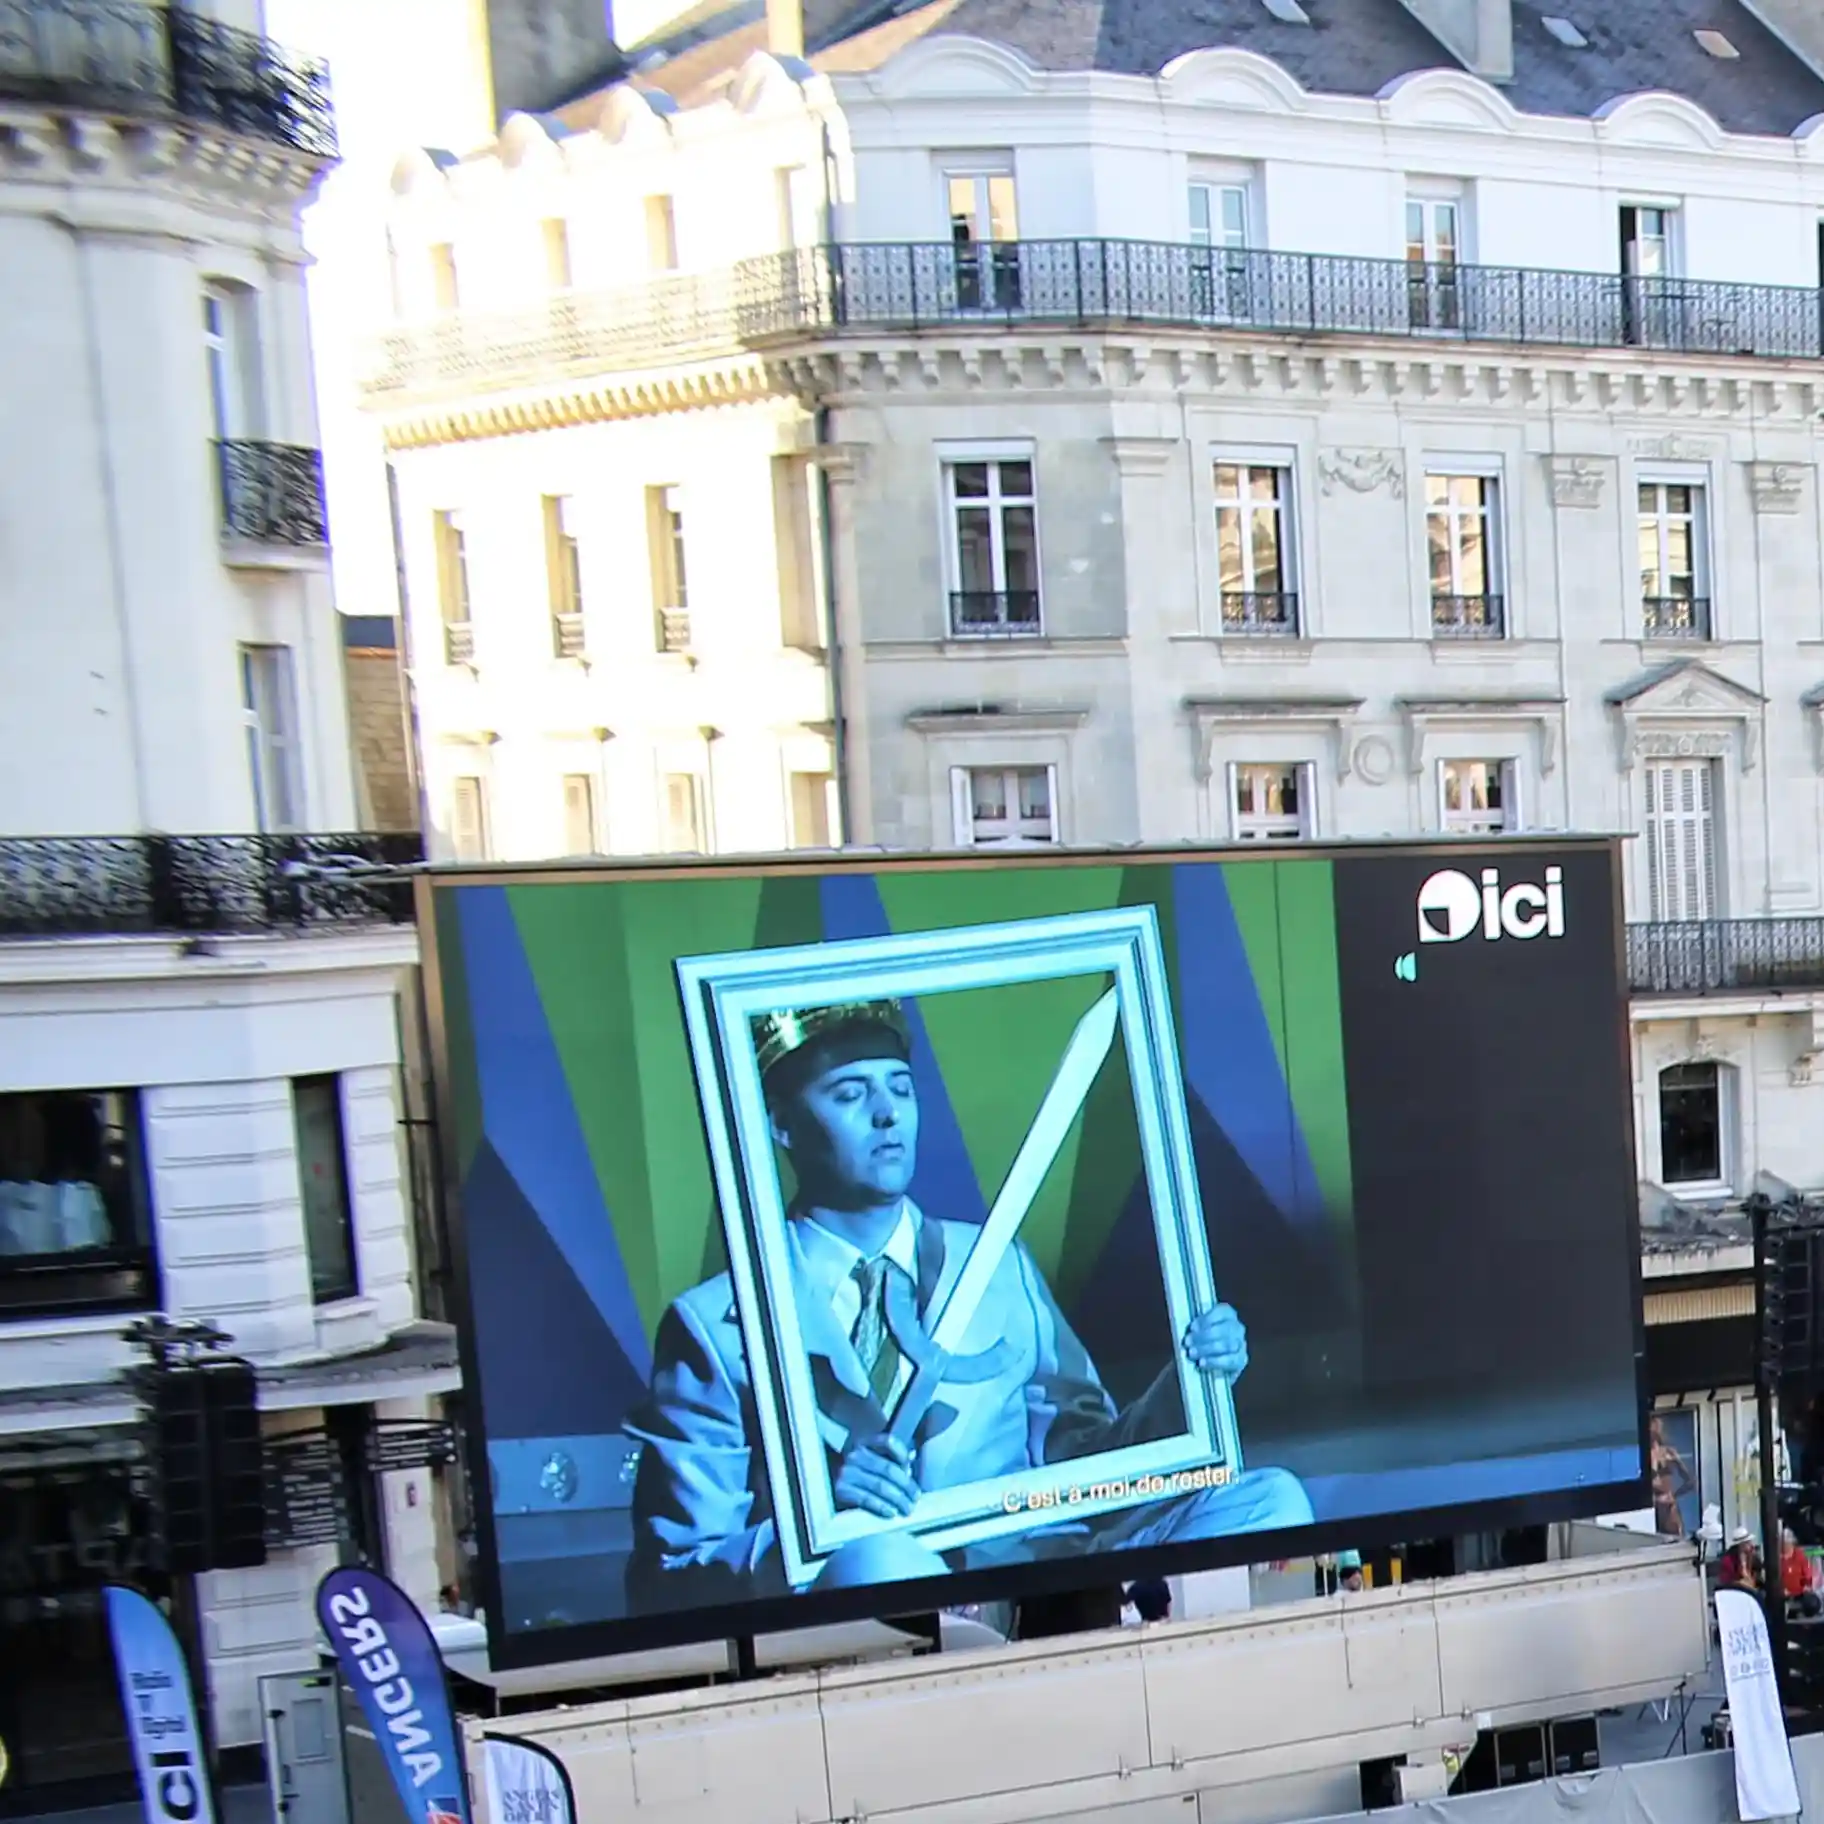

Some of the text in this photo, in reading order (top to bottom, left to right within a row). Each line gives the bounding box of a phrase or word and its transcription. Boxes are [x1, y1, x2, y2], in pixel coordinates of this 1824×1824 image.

[1481, 866, 1565, 940] ici
[1090, 1475, 1132, 1499] moi
[1137, 1472, 1164, 1494] de
